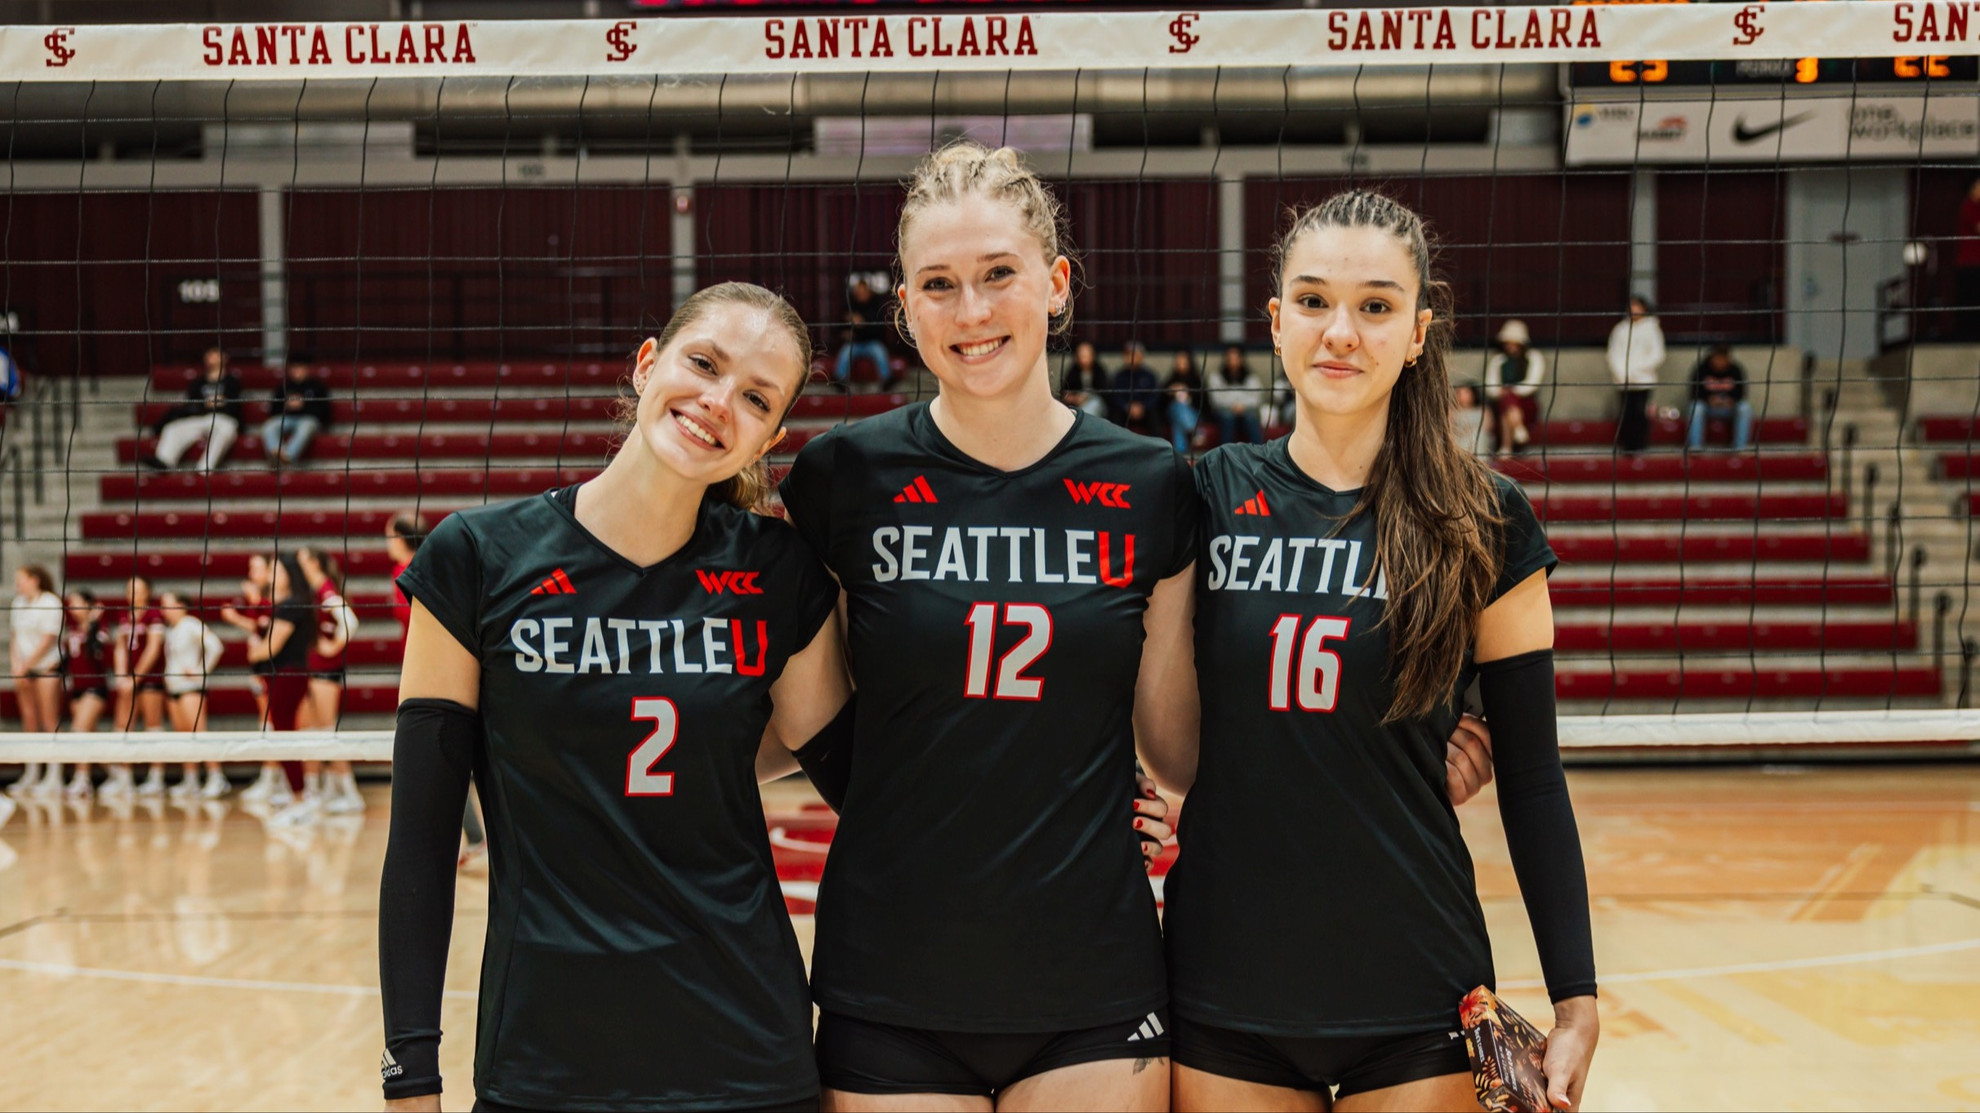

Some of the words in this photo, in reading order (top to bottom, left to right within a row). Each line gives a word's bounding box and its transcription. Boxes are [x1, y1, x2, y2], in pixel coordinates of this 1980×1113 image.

[765, 18, 893, 59] SANTA
[908, 16, 1038, 57] CLARA
[1328, 9, 1456, 51] SANTA
[1471, 8, 1601, 49] CLARA
[1893, 2, 1980, 42] SAN
[202, 25, 332, 66] SANTA
[345, 23, 476, 65] CLARA
[1063, 478, 1132, 509] WCC
[695, 569, 765, 596] WCC
[1208, 534, 1389, 600] SEATTL
[963, 601, 1054, 702] 12
[1268, 613, 1352, 713] 16
[624, 696, 679, 797] 2
